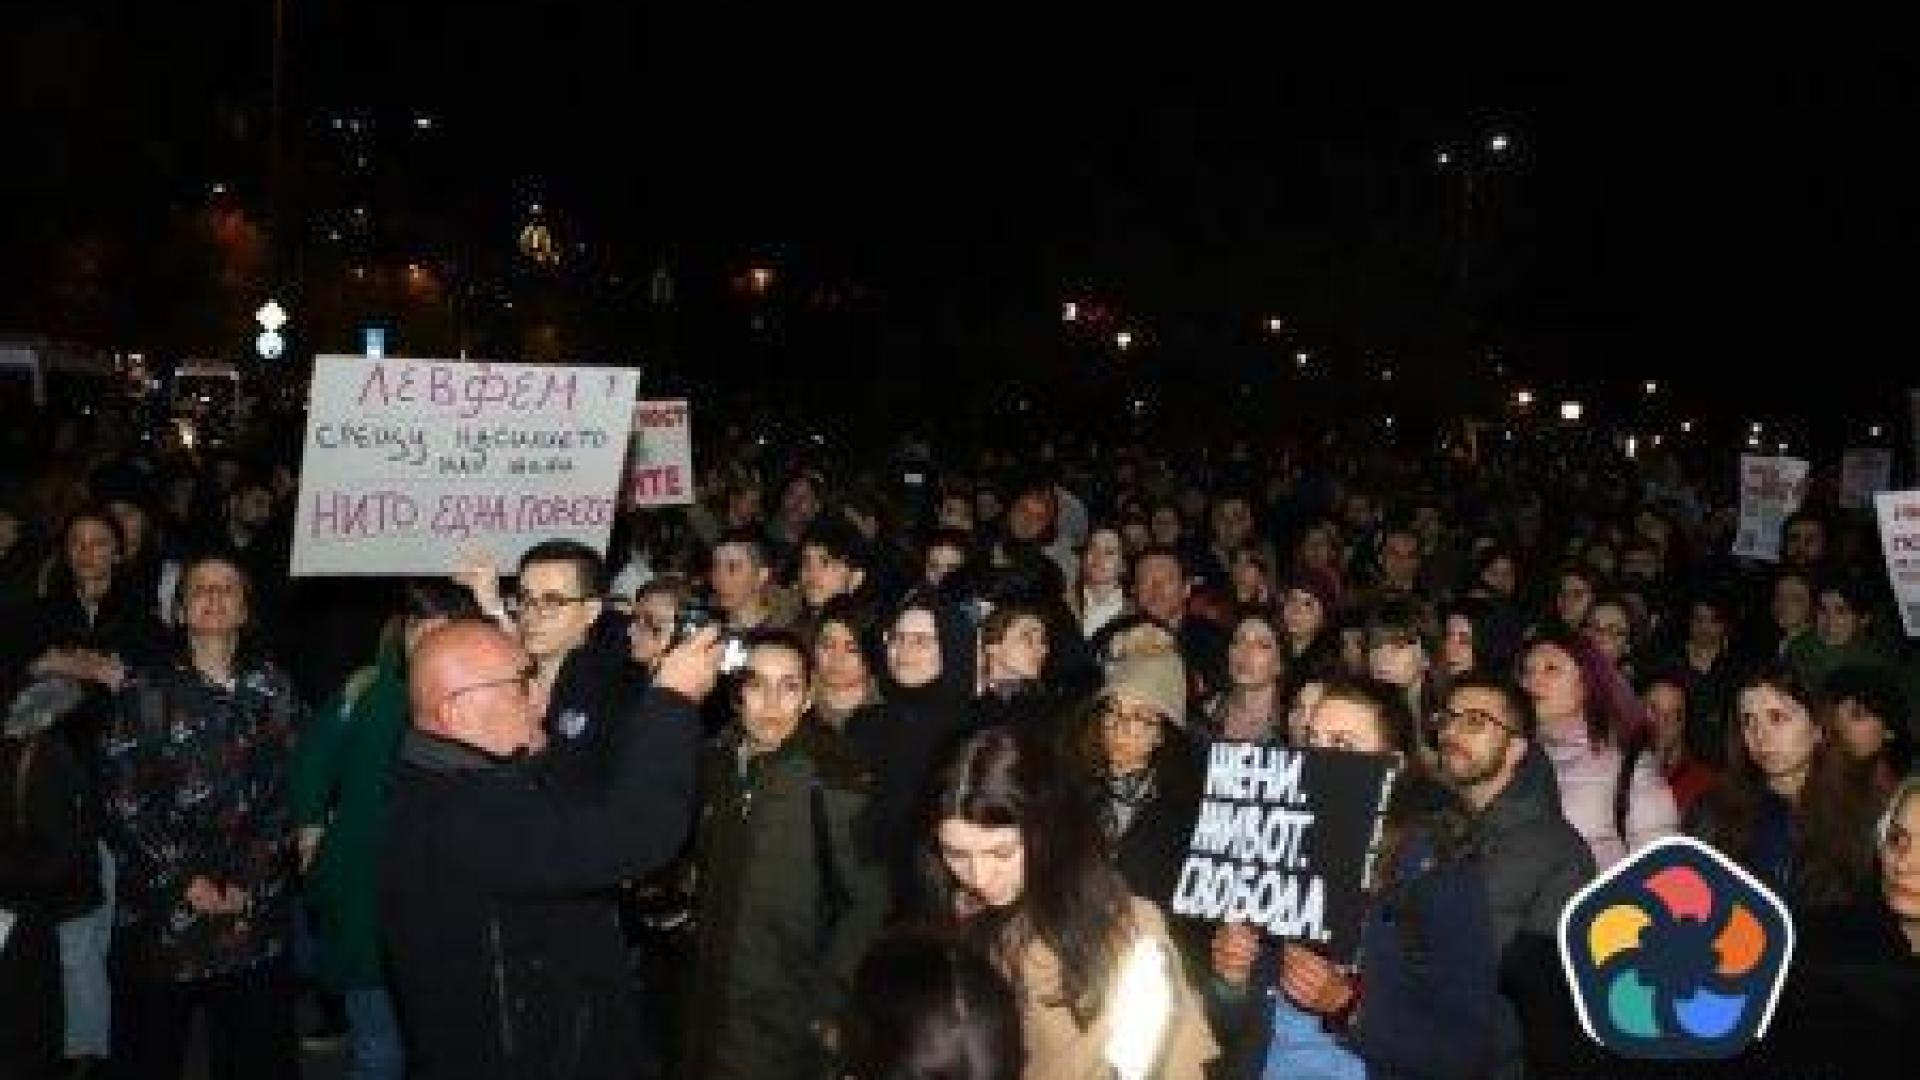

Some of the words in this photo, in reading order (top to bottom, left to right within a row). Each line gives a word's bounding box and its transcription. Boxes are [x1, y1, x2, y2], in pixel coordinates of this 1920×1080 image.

[358, 362, 577, 418] ЛЕВФЕМ
[310, 490, 419, 539] НИТО
[1172, 855, 1333, 943] СВОБОДА.
